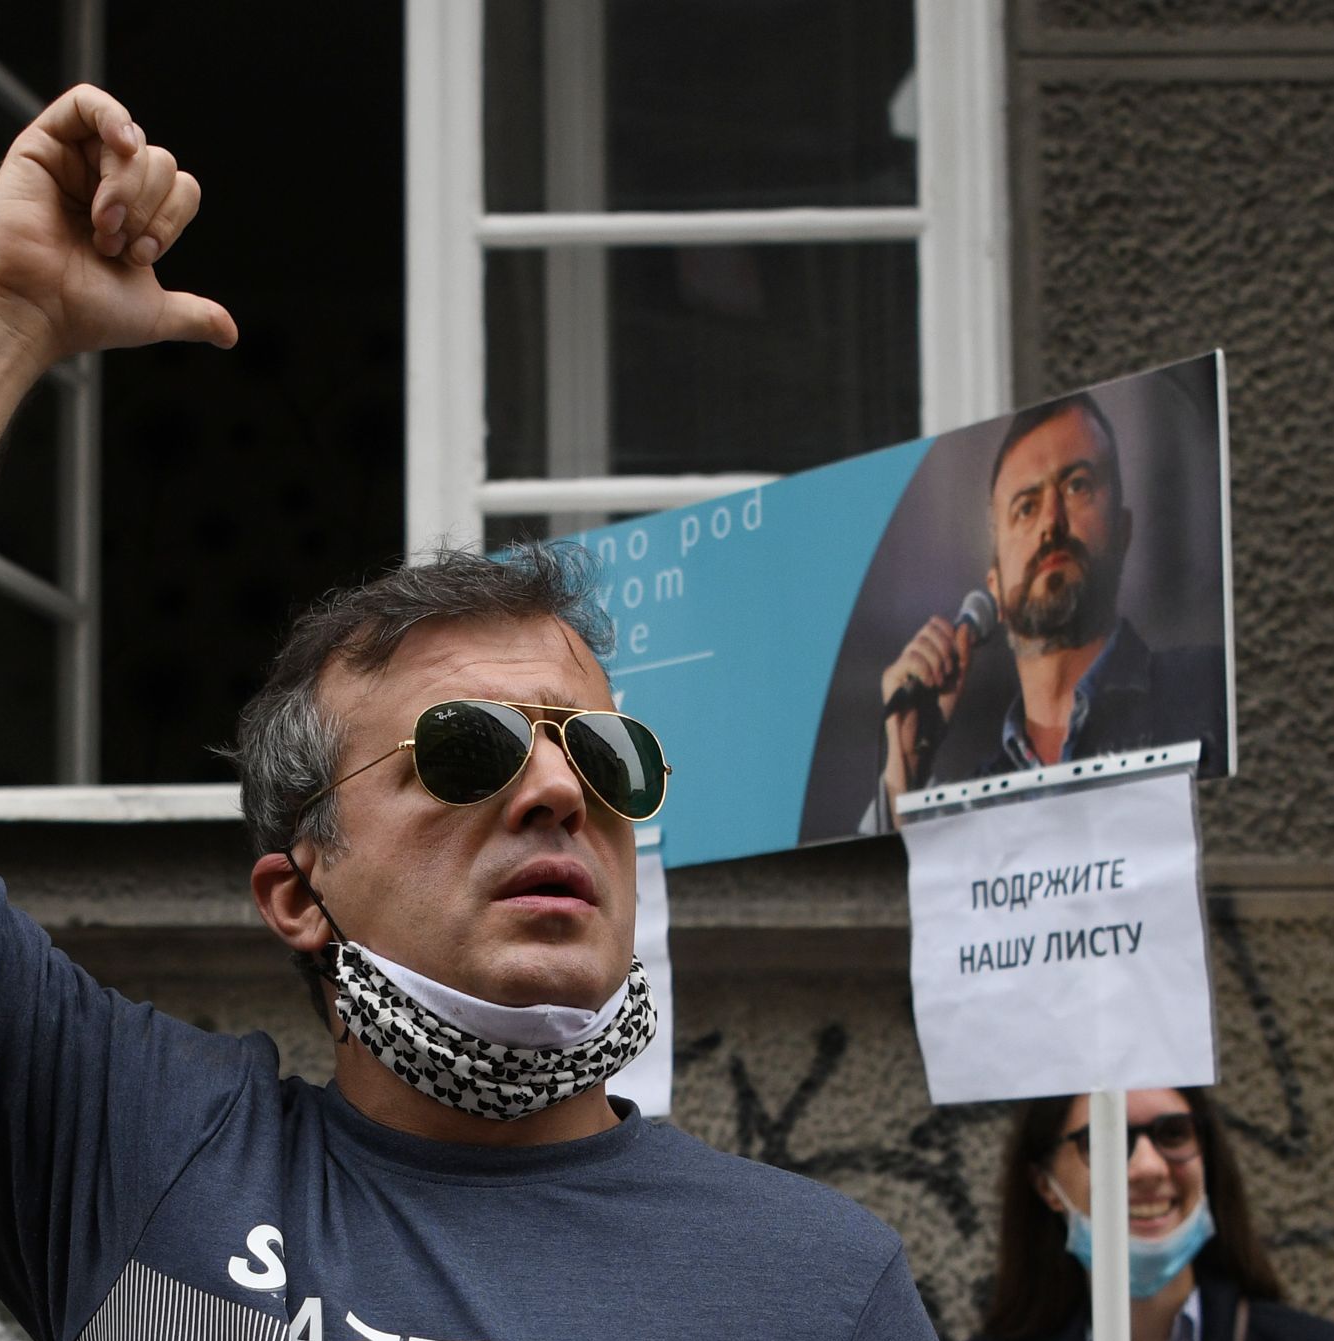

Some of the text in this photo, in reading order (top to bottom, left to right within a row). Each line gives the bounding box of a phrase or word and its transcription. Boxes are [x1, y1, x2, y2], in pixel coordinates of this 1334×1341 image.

[579, 487, 762, 563] no pod
[971, 858, 1126, 912] ПОДРЖИТЕ
[959, 920, 1143, 975] НАШУ ЛИСТУ
